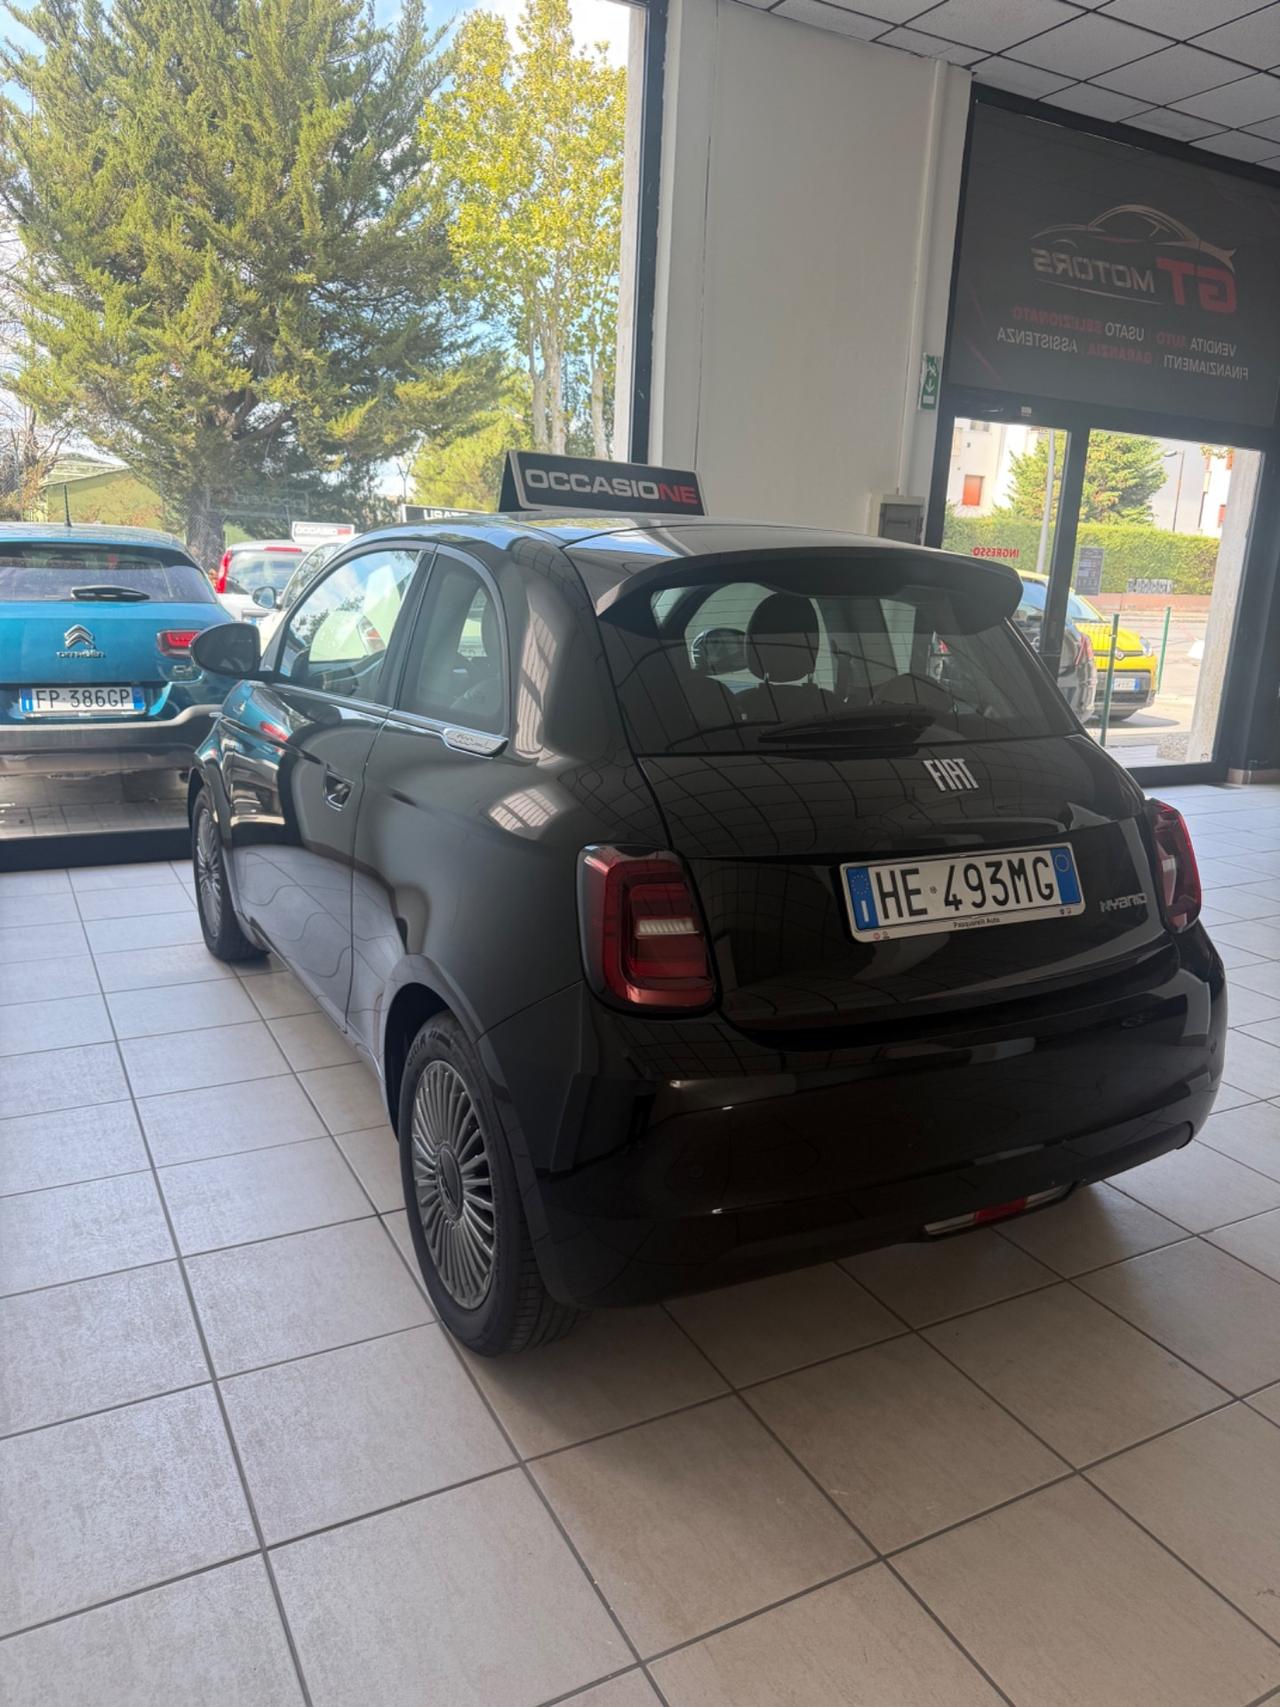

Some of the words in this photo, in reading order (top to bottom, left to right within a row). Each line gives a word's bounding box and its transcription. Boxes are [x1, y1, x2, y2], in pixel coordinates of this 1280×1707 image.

[524, 468, 698, 504] OCCASIONE
[35, 689, 60, 708] FP
[70, 688, 131, 708] 386GP
[923, 758, 979, 791] FIAT
[875, 868, 928, 919] HE
[943, 857, 1055, 911] 493MG
[1100, 892, 1148, 913] HYBRID
